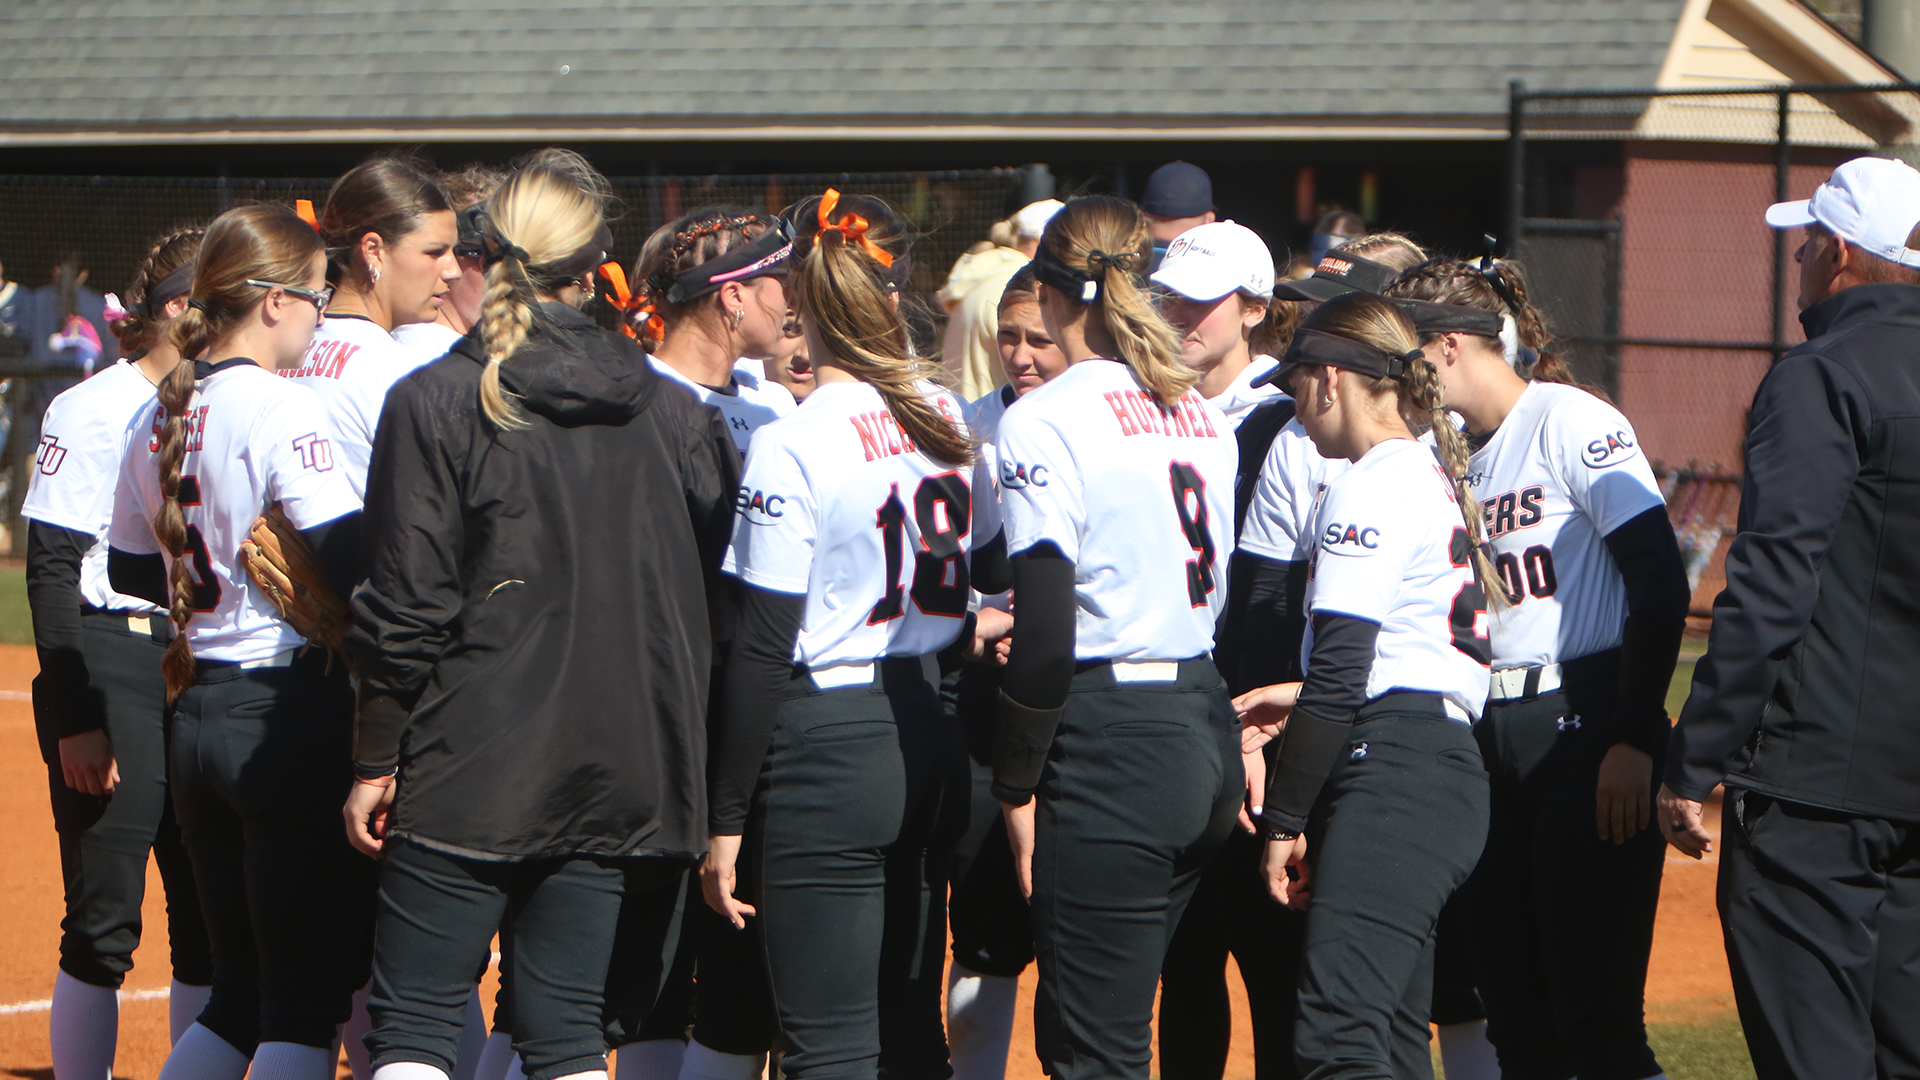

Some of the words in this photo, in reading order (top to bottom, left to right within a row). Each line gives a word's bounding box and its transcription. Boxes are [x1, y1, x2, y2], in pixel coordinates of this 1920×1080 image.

[37, 434, 68, 476] TU
[292, 431, 334, 473] TU
[1588, 430, 1633, 462] SAC
[1003, 459, 1049, 487] SAC
[737, 485, 786, 518] SAC
[1480, 485, 1545, 538] ERS
[866, 470, 972, 626] 18
[1168, 459, 1216, 609] 9
[1325, 523, 1381, 549] SAC
[1495, 544, 1558, 607] 00
